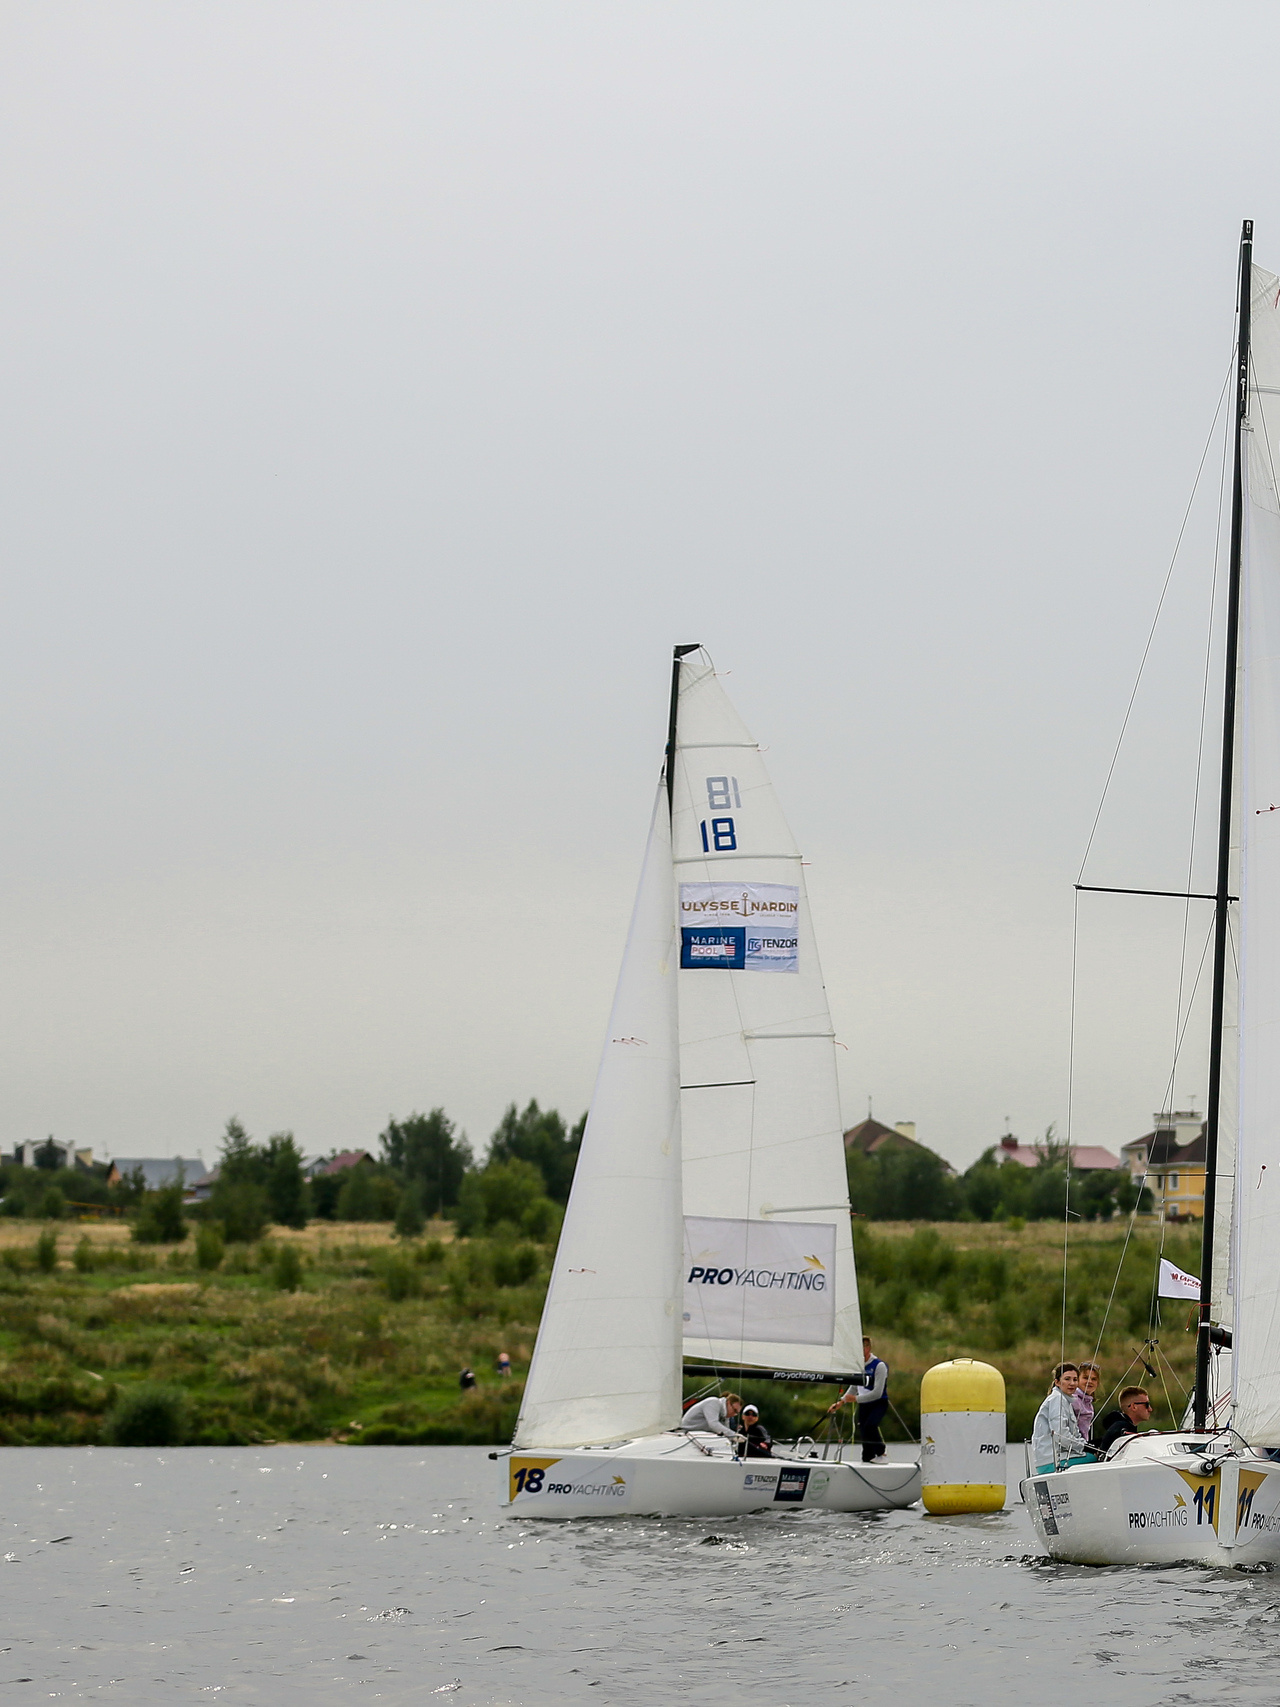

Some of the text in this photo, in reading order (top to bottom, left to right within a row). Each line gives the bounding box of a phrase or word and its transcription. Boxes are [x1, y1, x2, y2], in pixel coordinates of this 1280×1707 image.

[700, 817, 737, 852] 18
[681, 900, 798, 912] ULYSSE NARDIN
[690, 936, 736, 945] MARINE
[762, 939, 798, 948] TENZOR
[692, 947, 718, 955] POOL
[687, 1266, 826, 1291] PROYACHTING
[773, 1371, 825, 1382] pro-yachting.ru
[513, 1468, 545, 1493] 18
[754, 1475, 777, 1483] TENZOR
[547, 1483, 626, 1496] PROYACHTING
[1193, 1484, 1216, 1525] 11
[1238, 1487, 1255, 1527] 11
[1128, 1509, 1188, 1528] PROYACHTING
